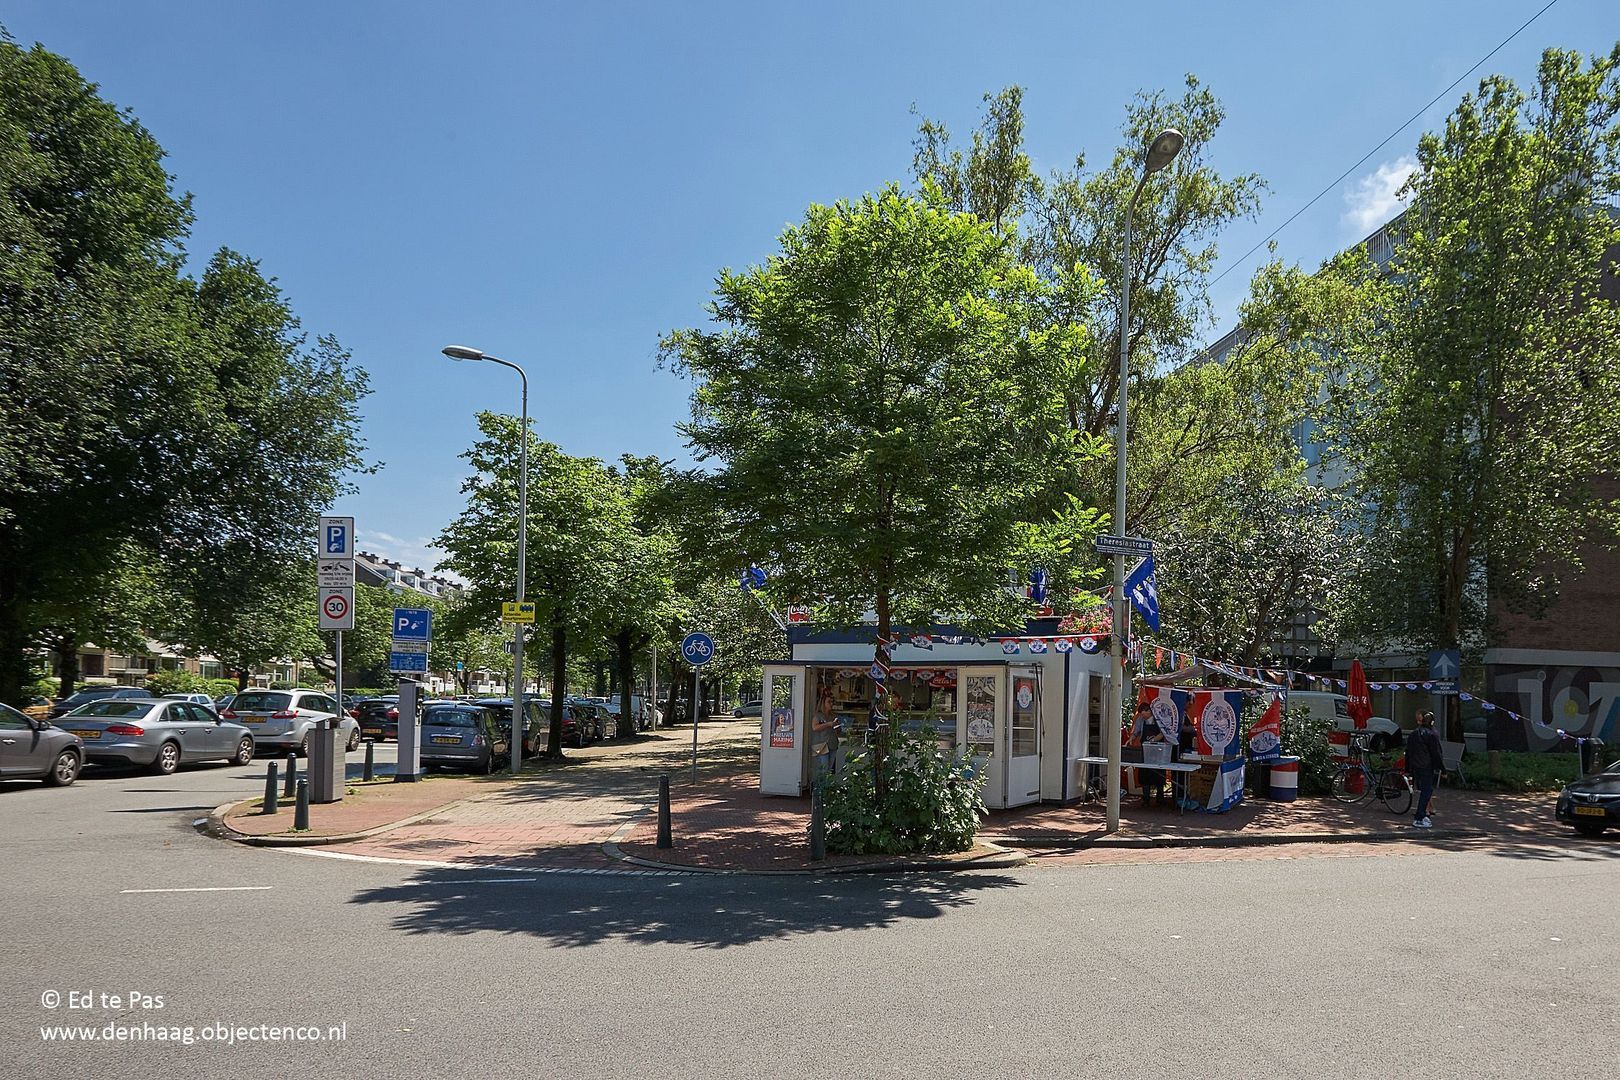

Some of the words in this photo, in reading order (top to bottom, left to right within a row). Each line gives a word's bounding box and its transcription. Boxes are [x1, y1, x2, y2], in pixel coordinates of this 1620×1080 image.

[331, 527, 341, 541] P
[1099, 537, 1150, 549] Theresiastraat
[328, 602, 343, 612] 30
[398, 617, 409, 631] P
